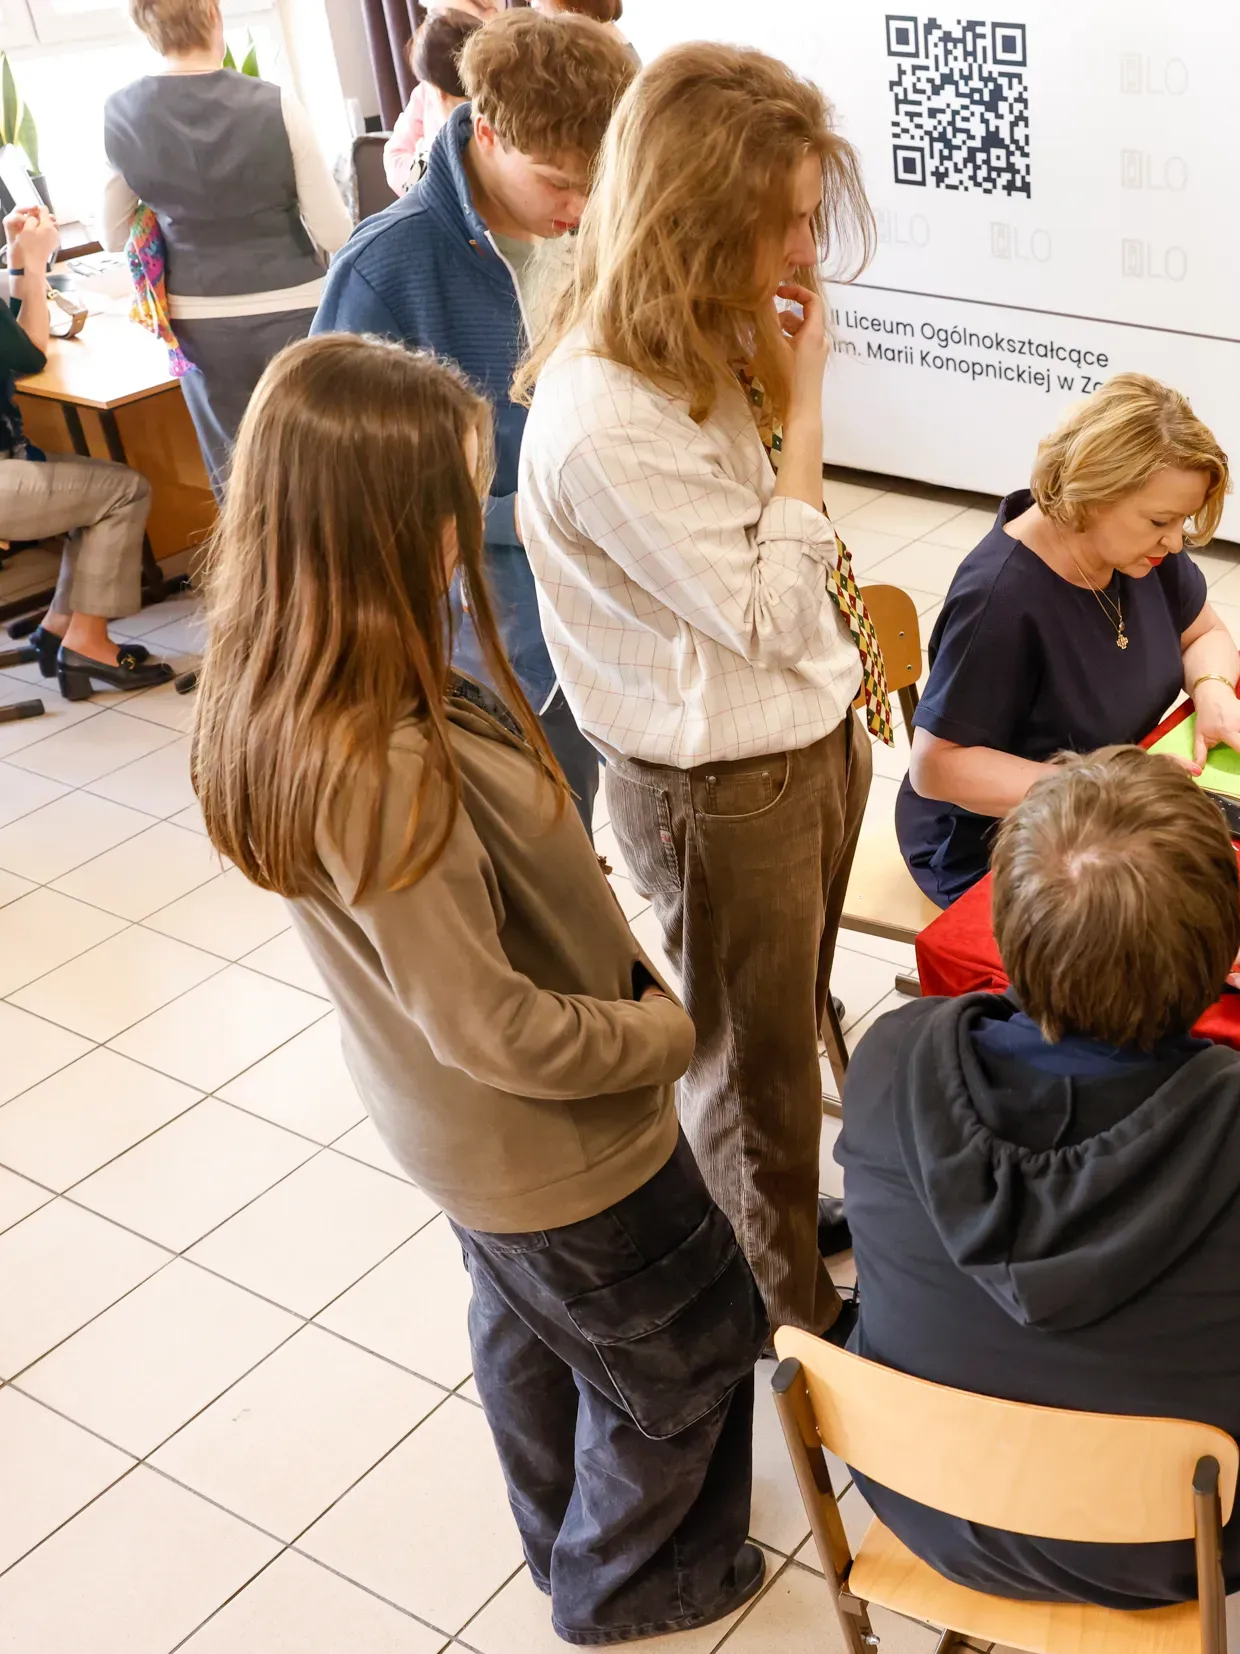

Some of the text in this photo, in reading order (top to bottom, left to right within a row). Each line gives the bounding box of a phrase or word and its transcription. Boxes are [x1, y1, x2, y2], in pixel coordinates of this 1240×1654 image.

[846, 311, 914, 337] Liceum
[920, 322, 1109, 368] Ogólnokształcące
[867, 341, 914, 365] Marii
[920, 350, 1051, 393] Konopnickiej
[1057, 374, 1074, 391] w
